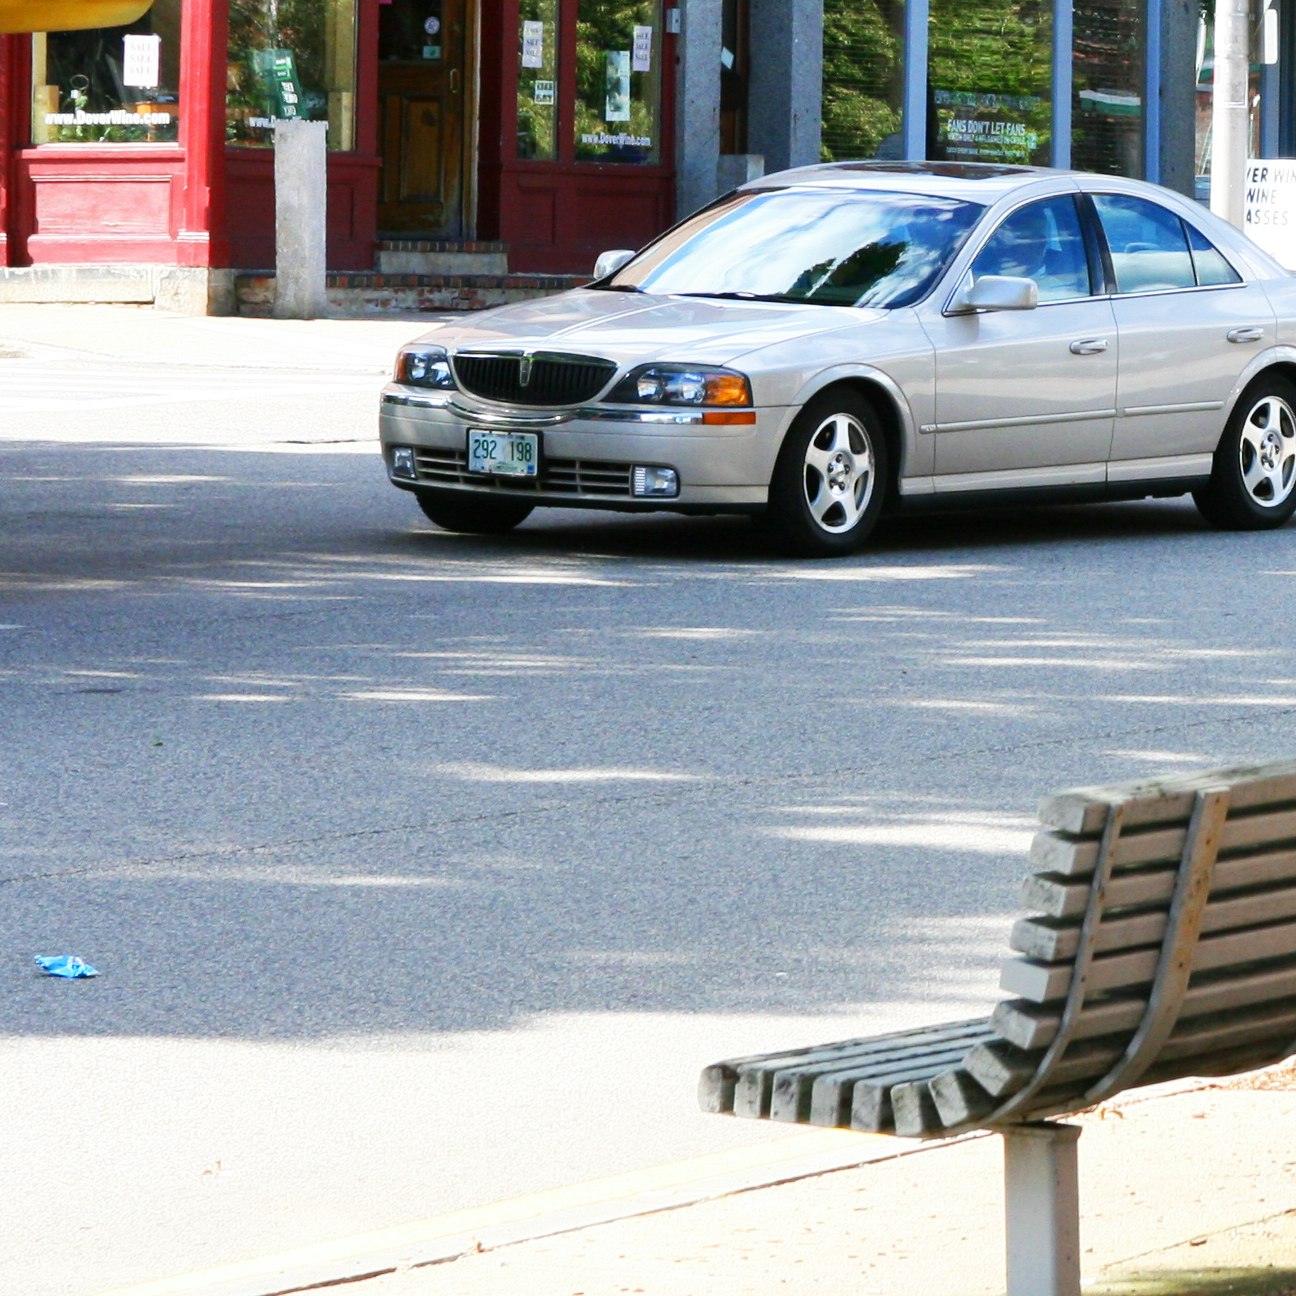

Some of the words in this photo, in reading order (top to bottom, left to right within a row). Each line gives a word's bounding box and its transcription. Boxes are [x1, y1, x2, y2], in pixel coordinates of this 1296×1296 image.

[44, 109, 170, 125] www.DoverWine.com
[947, 119, 967, 132] FANS
[968, 120, 990, 134] DON'T
[991, 121, 1006, 135] LET
[1006, 123, 1026, 136] FANS
[473, 438, 497, 460] 292
[511, 441, 532, 462] 198
